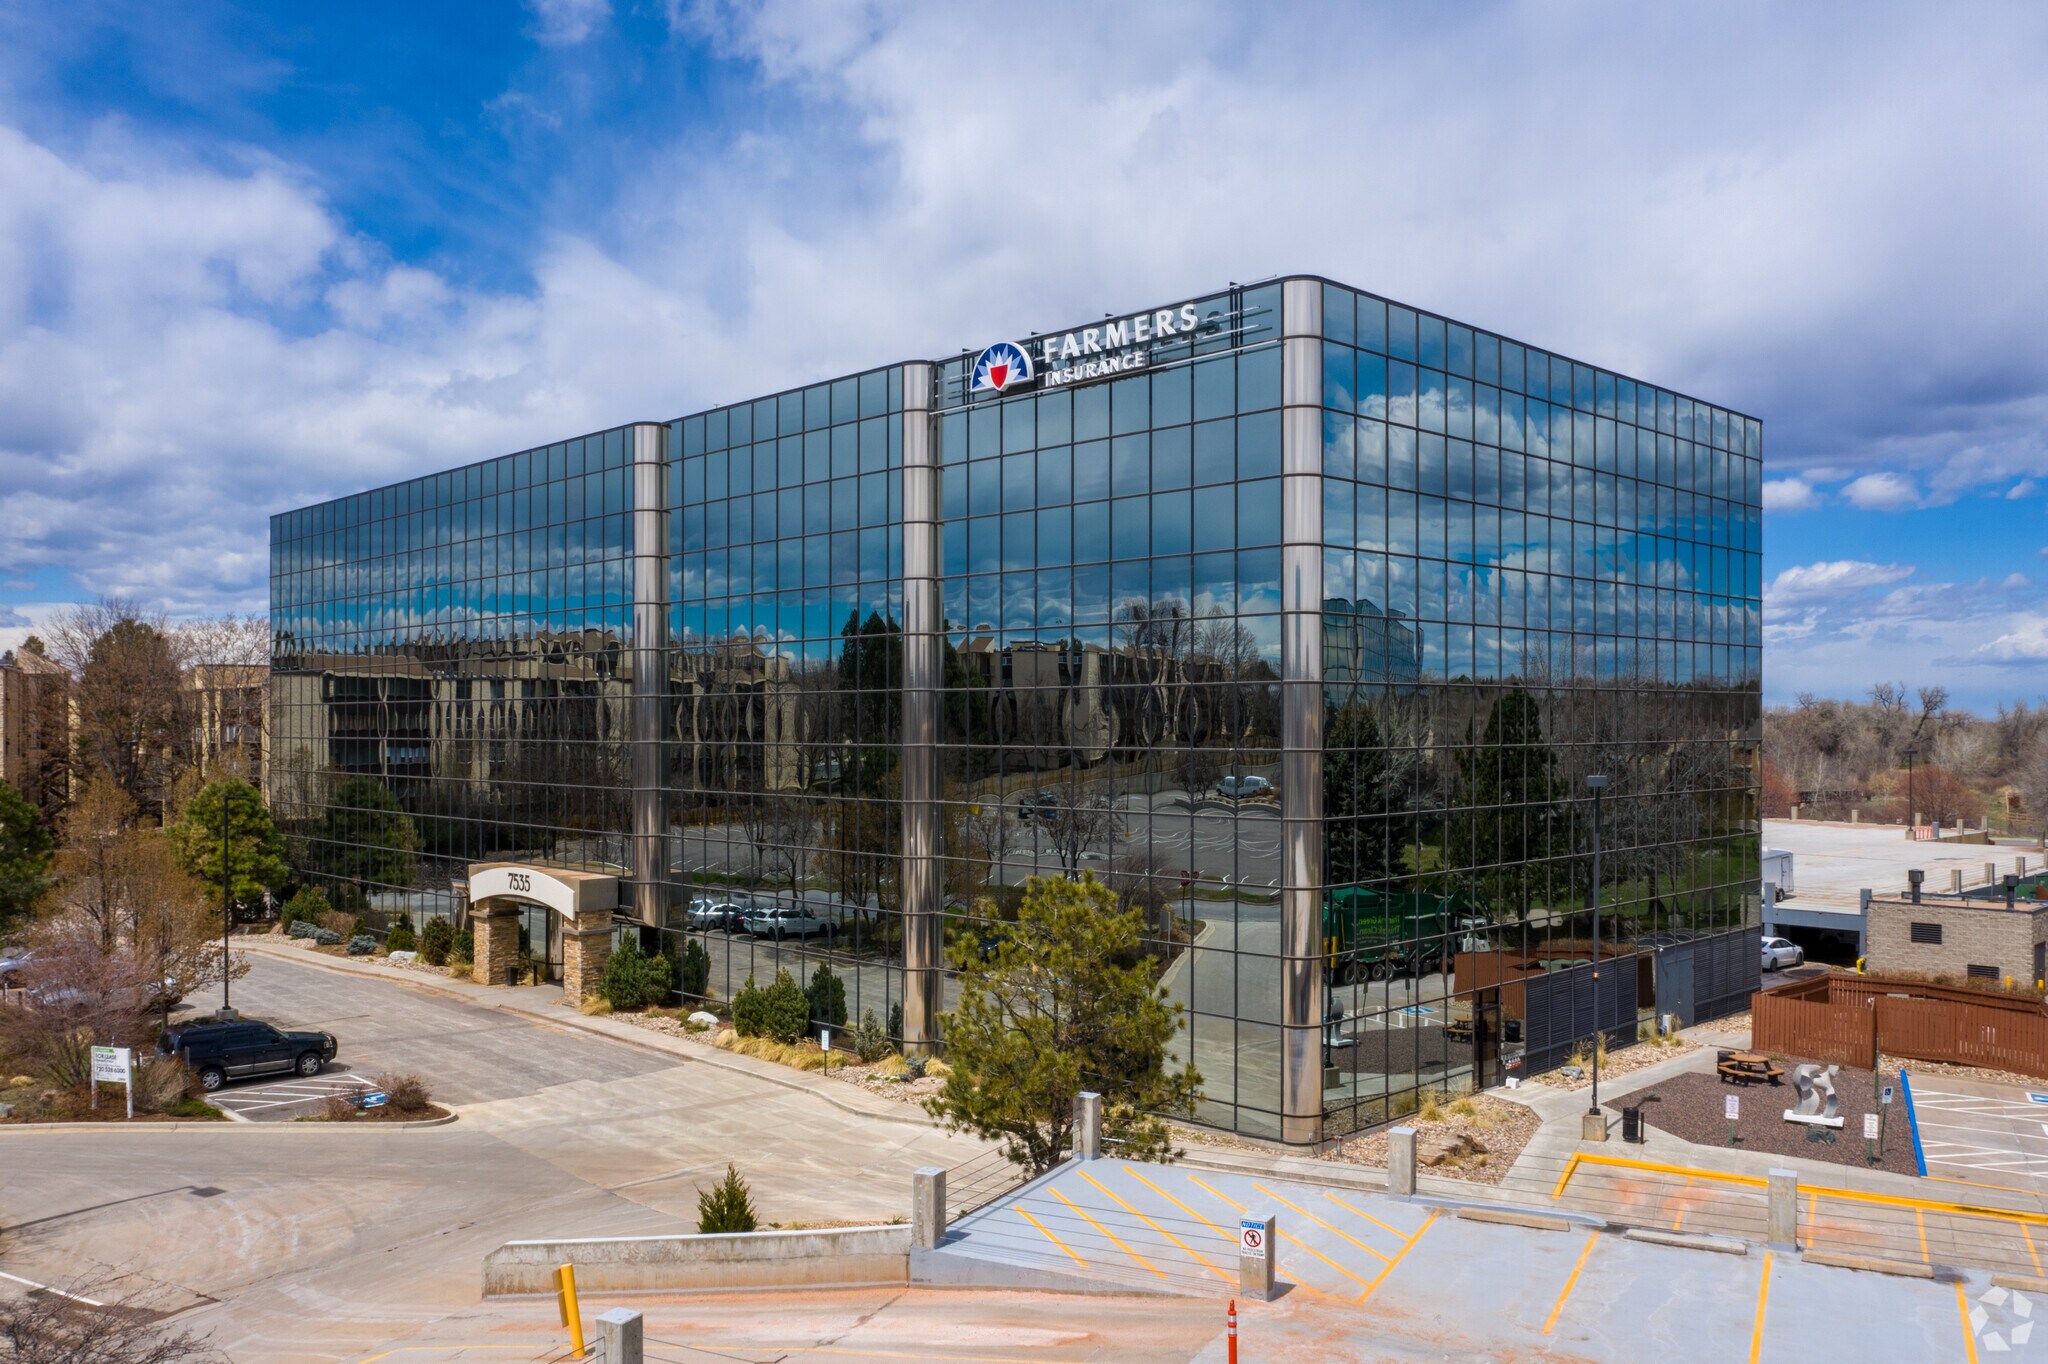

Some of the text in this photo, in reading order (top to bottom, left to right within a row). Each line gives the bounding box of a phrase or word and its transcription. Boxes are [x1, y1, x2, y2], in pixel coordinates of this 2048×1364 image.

[1044, 303, 1199, 363] FARMERS
[1044, 351, 1146, 388] INSURANCE
[508, 872, 530, 892] 7535
[1241, 1221, 1264, 1229] NOTICE
